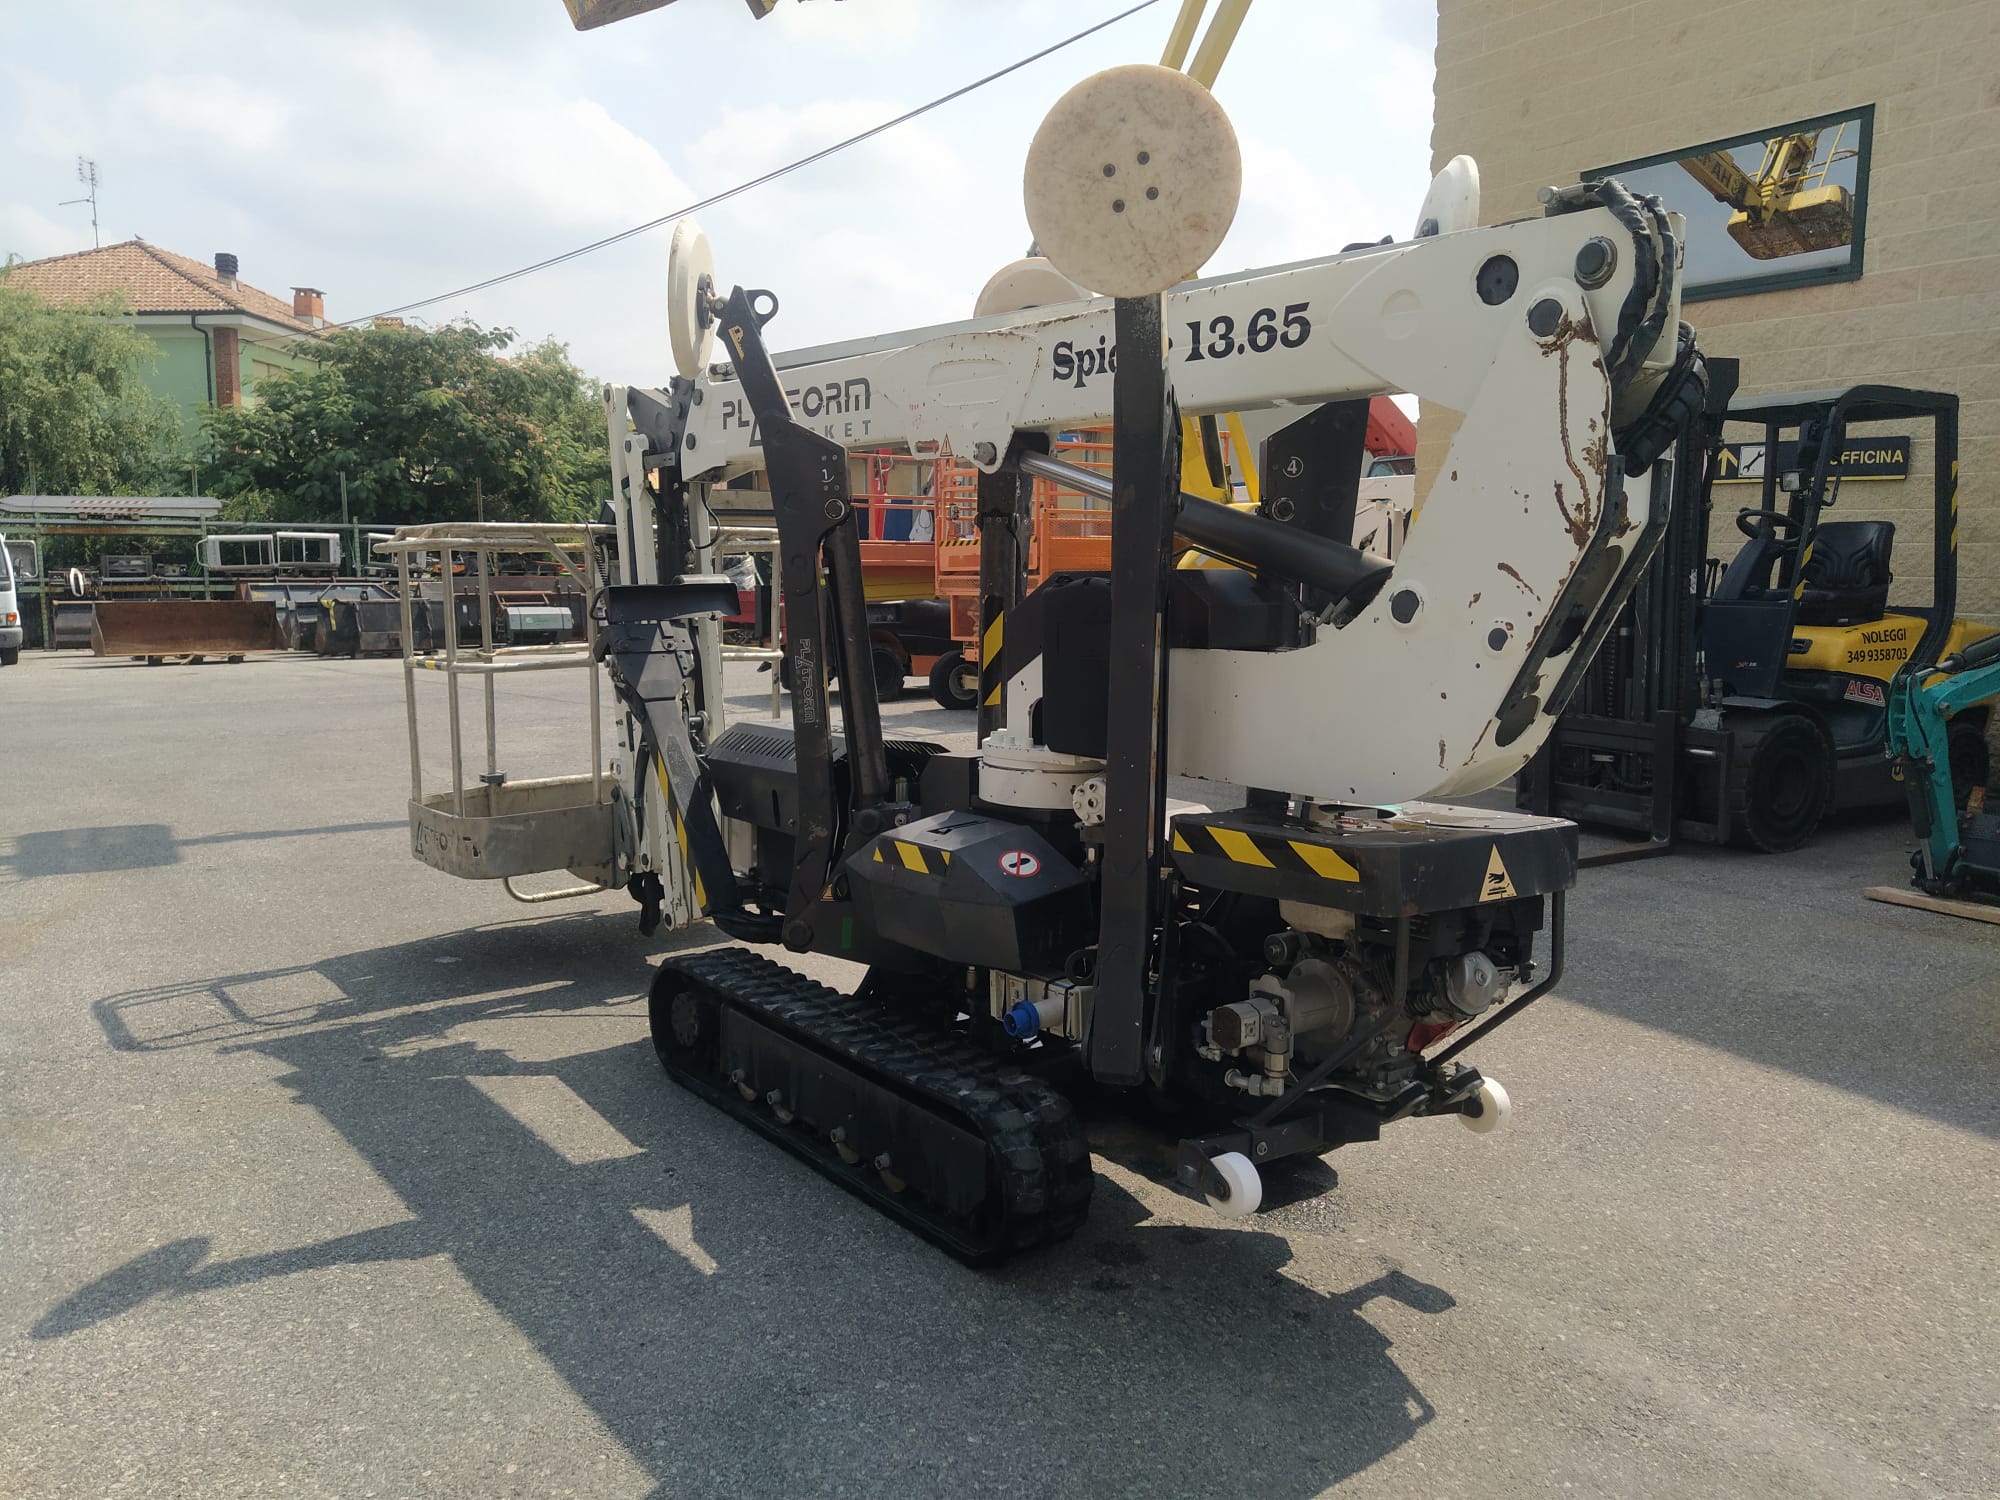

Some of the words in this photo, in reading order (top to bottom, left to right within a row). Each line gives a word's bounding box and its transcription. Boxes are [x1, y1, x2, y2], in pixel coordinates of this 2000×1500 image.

[1053, 335, 1173, 388] Spi
[1184, 302, 1312, 362] 13.65
[722, 377, 871, 447] PLFORM
[1847, 649, 1866, 664] 349
[1867, 648, 1908, 662] 9358703
[1861, 628, 1907, 644] NOLEGGI
[795, 639, 816, 723] PLATFORM
[1846, 680, 1884, 703] ALSA
